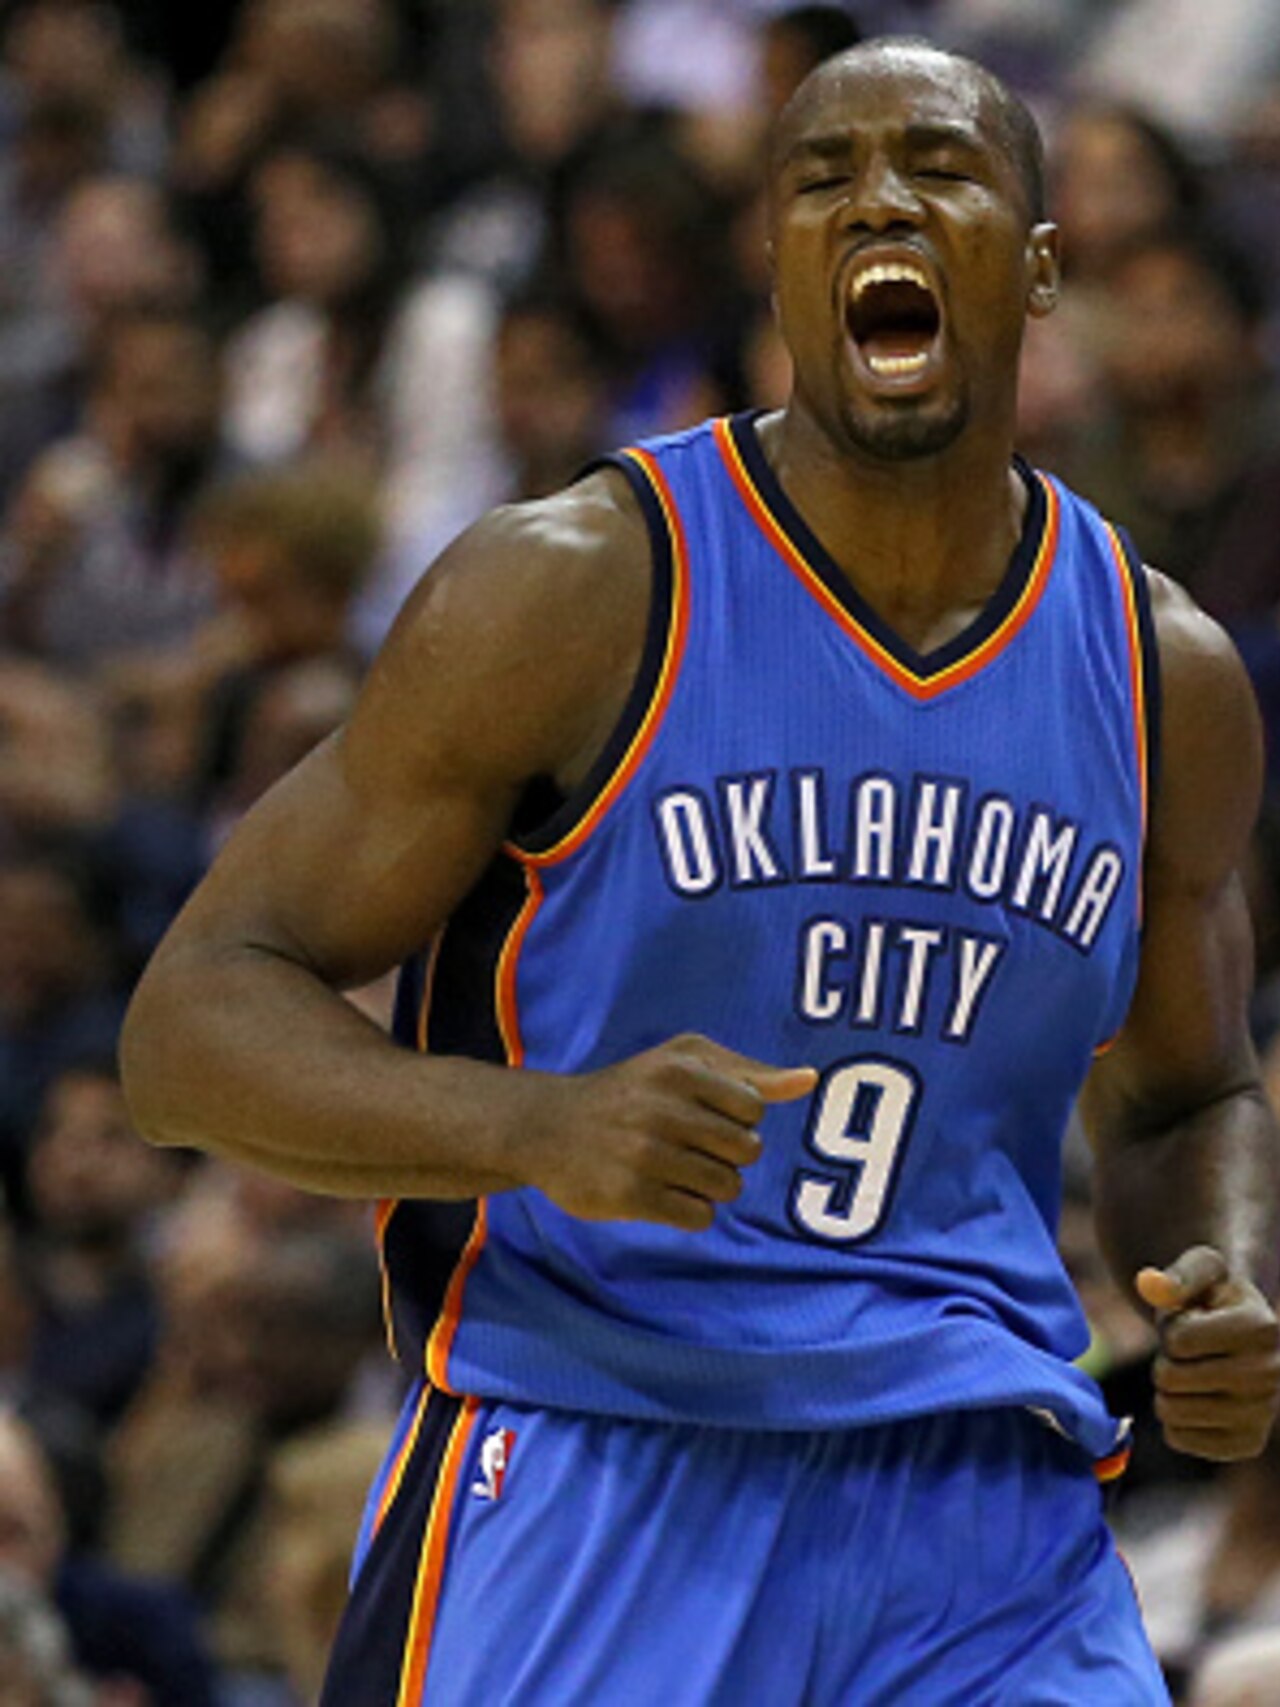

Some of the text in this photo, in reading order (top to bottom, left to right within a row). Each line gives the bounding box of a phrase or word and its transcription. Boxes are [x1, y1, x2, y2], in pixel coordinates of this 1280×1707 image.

[654, 768, 1126, 955] OKLAHOMA
[798, 916, 1008, 1044] CITY
[787, 1053, 924, 1246] 9
